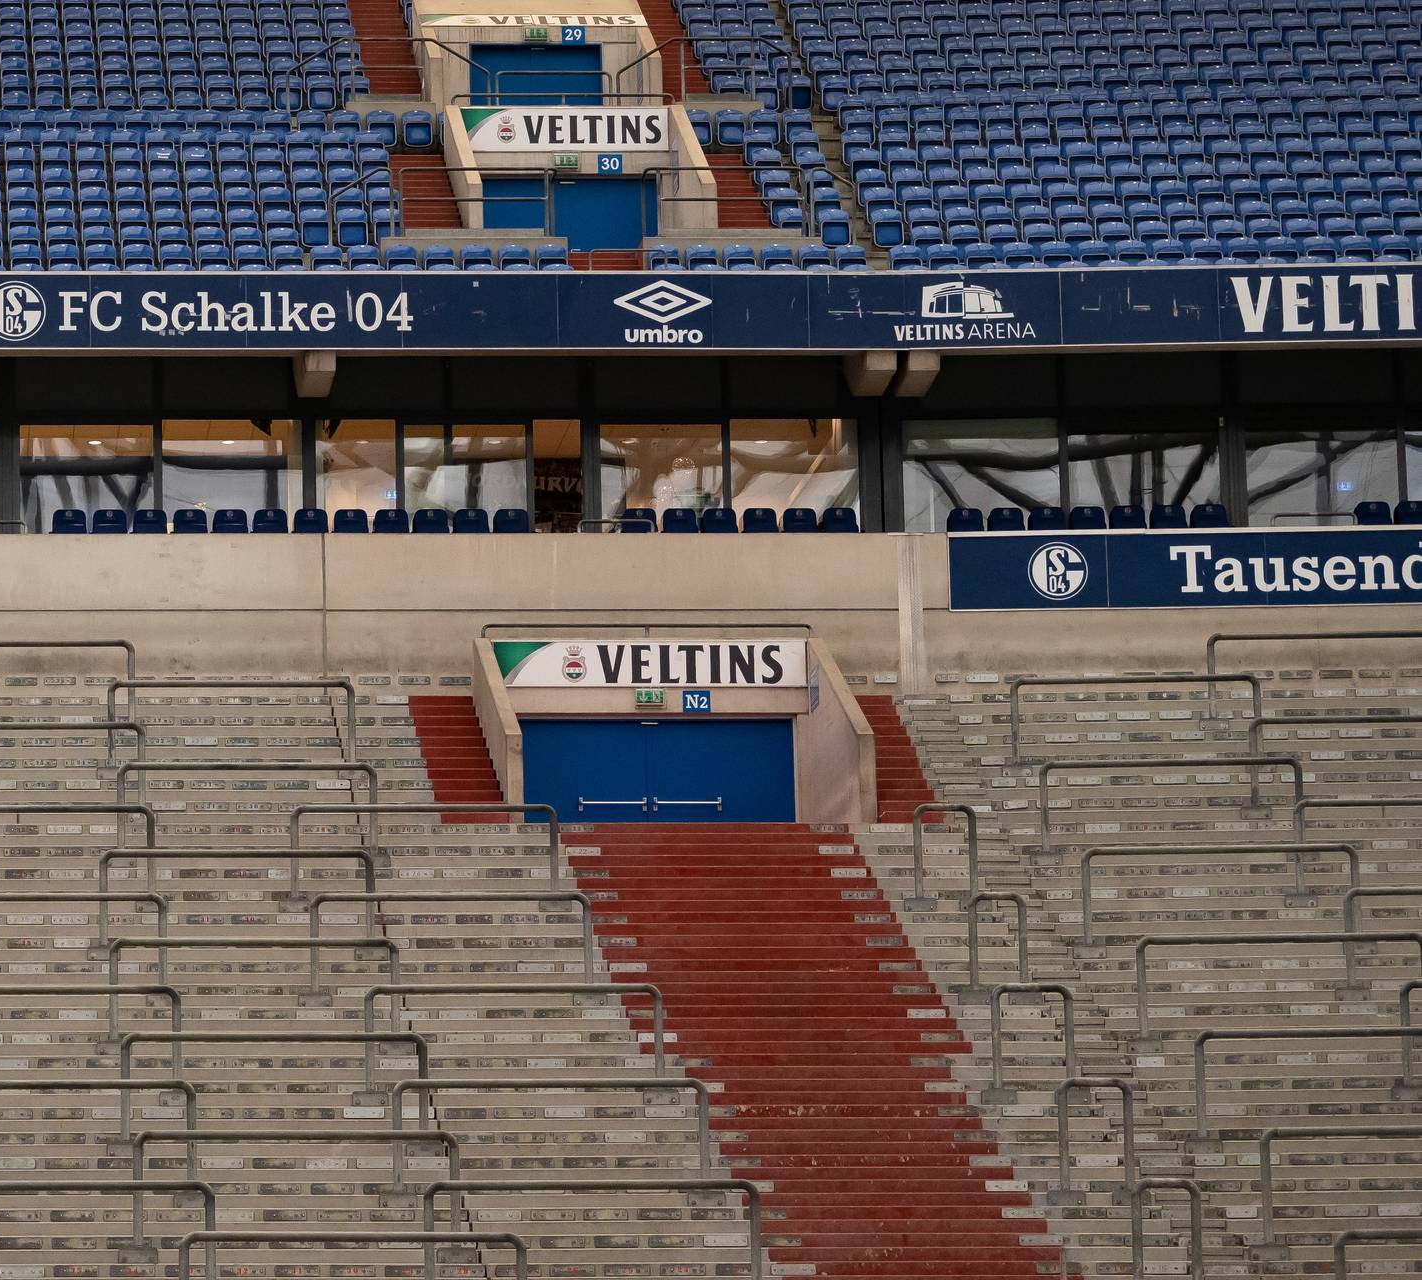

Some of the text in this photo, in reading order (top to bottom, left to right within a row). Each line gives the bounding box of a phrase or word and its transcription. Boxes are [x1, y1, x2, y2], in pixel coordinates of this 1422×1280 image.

[488, 15, 637, 25] VELTINS
[564, 28, 582, 41] 29
[522, 114, 662, 145] VELTINS
[601, 157, 620, 171] 30
[58, 290, 414, 332] FC Schalke 04
[1230, 273, 1417, 333] VELTI
[625, 325, 704, 344] umbro
[893, 322, 1037, 342] VELTINS ARENA
[596, 644, 784, 685] VELTINS
[685, 694, 708, 709] N2
